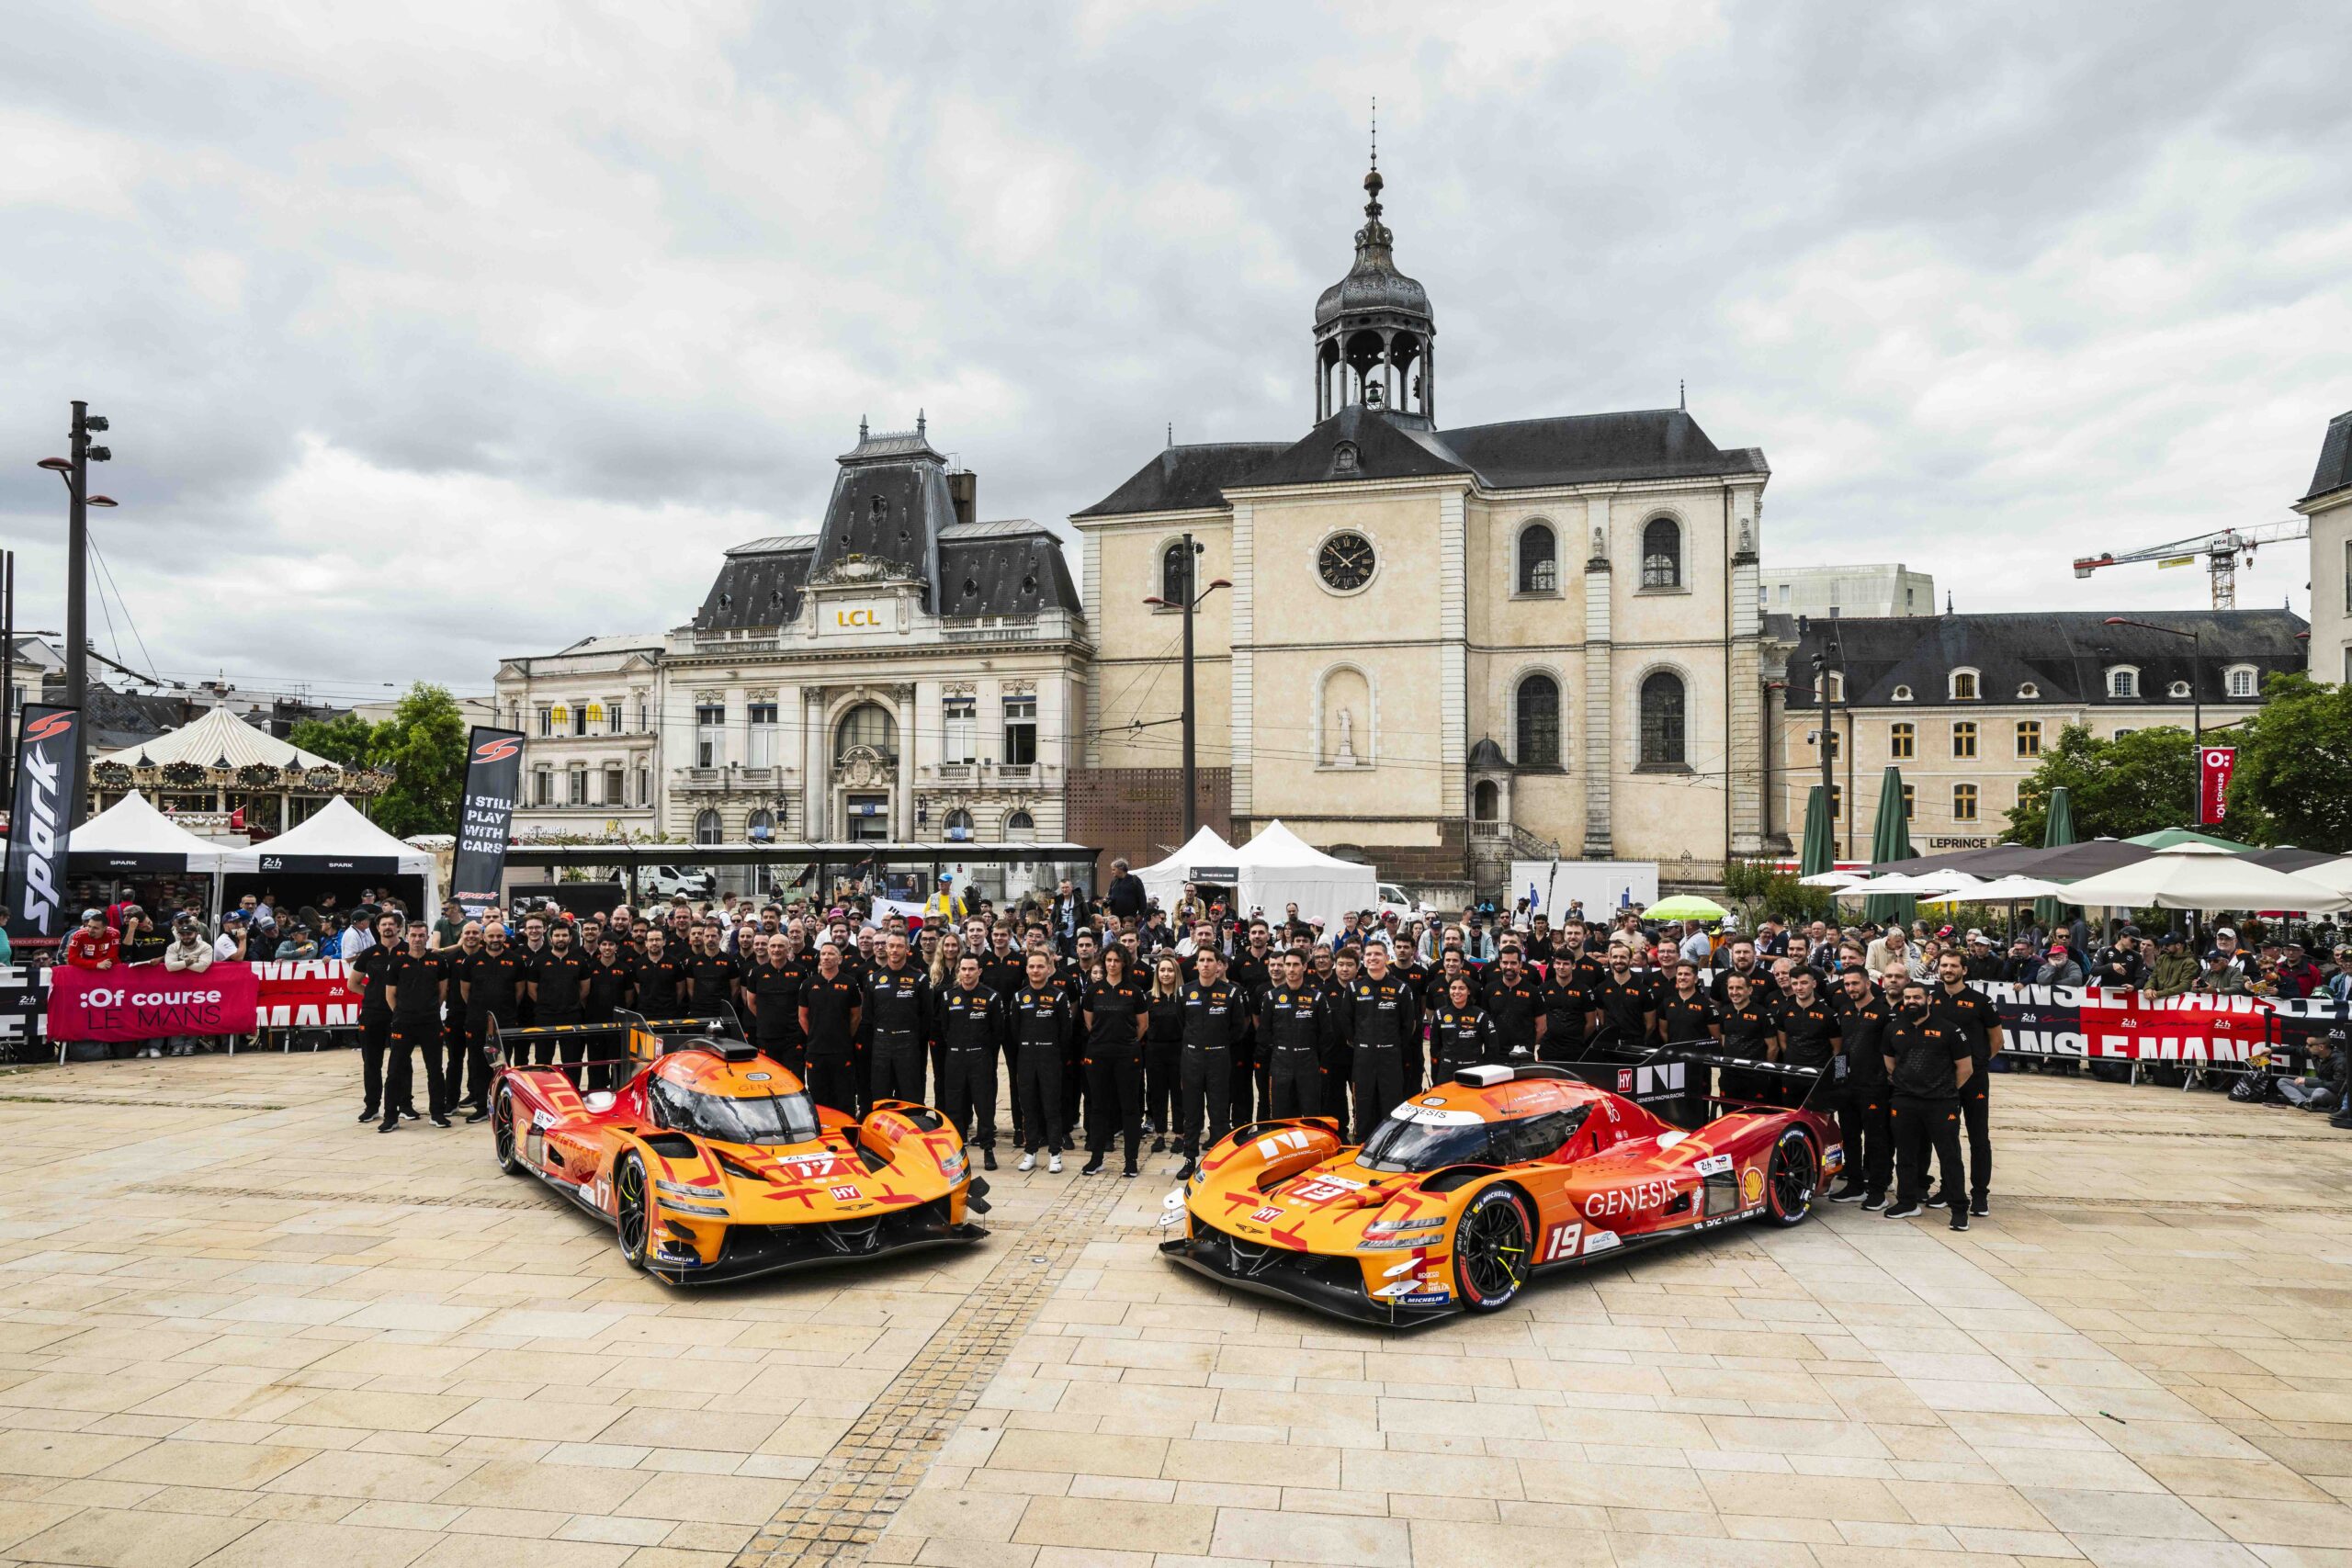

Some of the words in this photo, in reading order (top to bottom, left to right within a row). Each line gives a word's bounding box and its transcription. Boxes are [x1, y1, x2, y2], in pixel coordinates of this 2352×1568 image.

[837, 609, 881, 626] LCL
[465, 794, 470, 806] I
[475, 795, 514, 811] STILL
[467, 809, 505, 825] PLAY
[24, 740, 61, 936] spark
[464, 824, 504, 840] WITH
[522, 825, 567, 835] Mconald's
[462, 840, 503, 854] CARS
[1929, 838, 1987, 849] LEPRINCE
[455, 890, 499, 900] spark
[131, 989, 221, 1006] course
[87, 1009, 123, 1030] LE
[138, 1004, 221, 1029] MANS
[256, 1003, 362, 1027] MAN
[739, 1081, 794, 1091] GENESIS
[1619, 1073, 1631, 1088] HY
[1400, 1105, 1448, 1119] GENESIS
[632, 1156, 646, 1177] MICHELIN
[797, 1159, 834, 1177] 17
[831, 1186, 855, 1199] HY
[1292, 1182, 1347, 1201] 19
[1483, 1191, 1511, 1204] MICHELIN
[1585, 1179, 1679, 1217] GENESIS
[1254, 1206, 1282, 1221] HY
[1546, 1223, 1582, 1260] 19
[662, 1255, 695, 1263] MICHELIN
